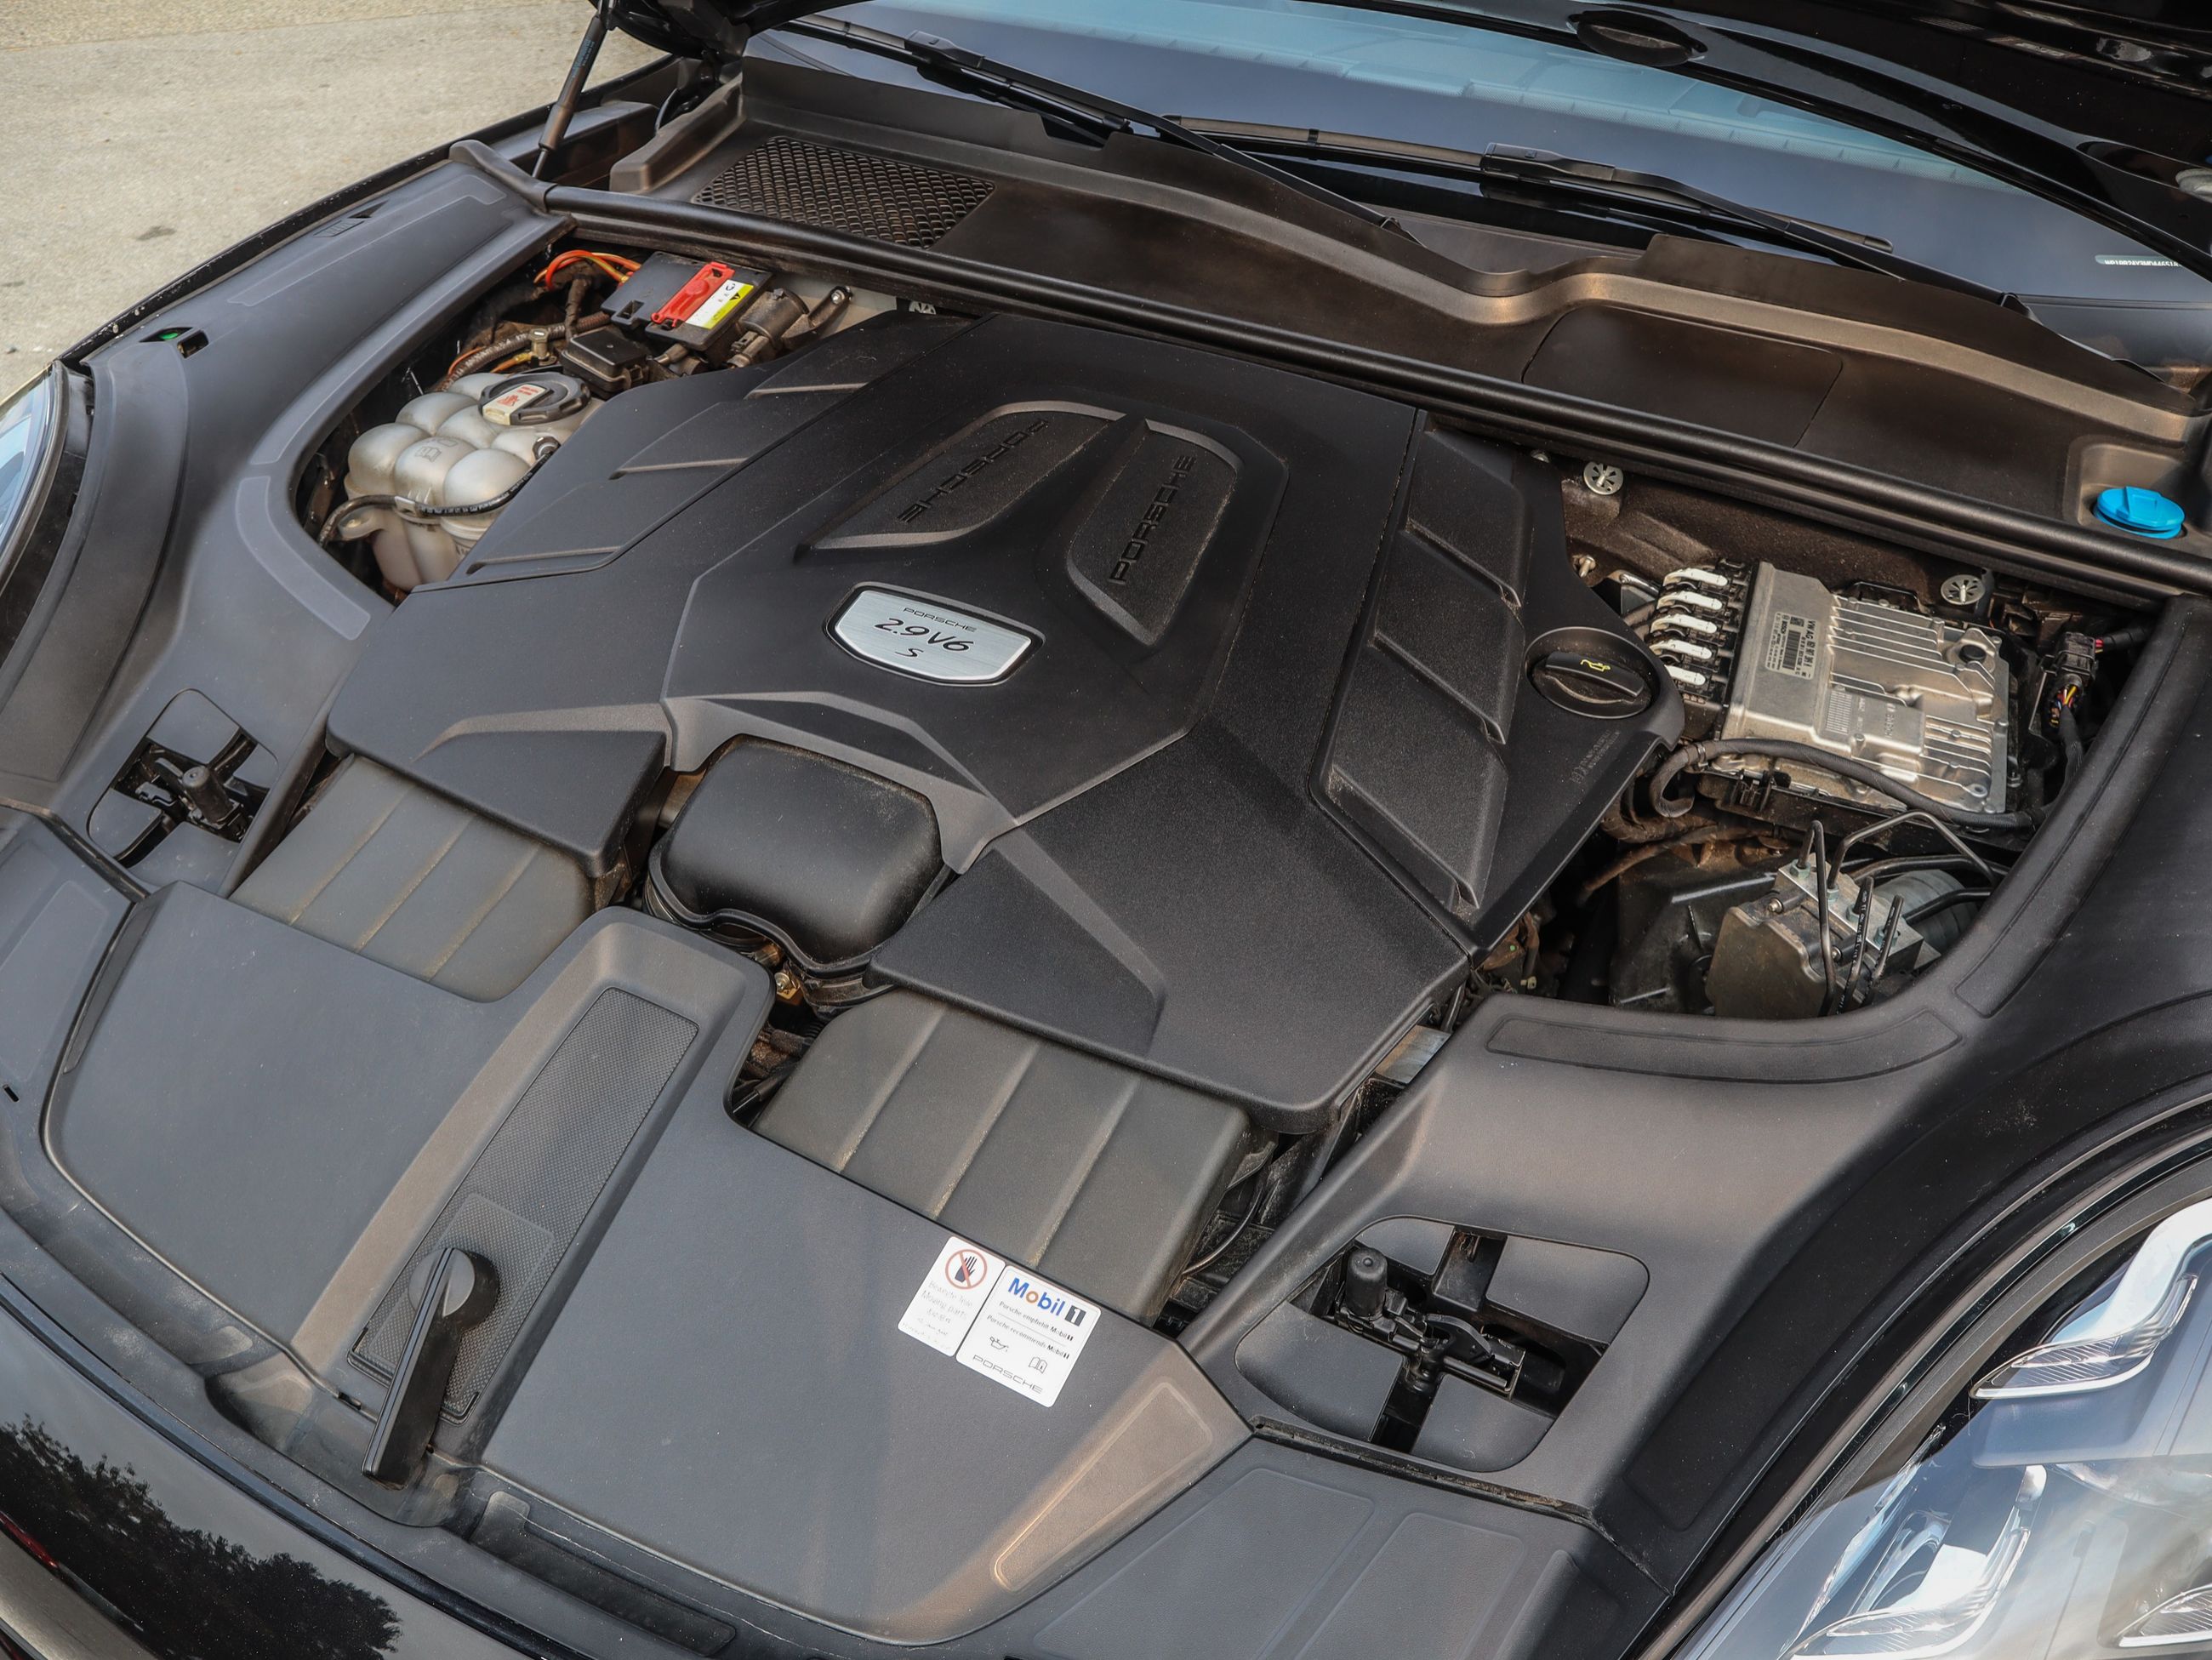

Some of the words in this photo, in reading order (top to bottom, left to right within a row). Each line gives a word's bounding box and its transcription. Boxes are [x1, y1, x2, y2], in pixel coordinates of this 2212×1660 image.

[897, 418, 1049, 524] PORSCHE
[1109, 454, 1197, 585] PORSCHE
[903, 607, 978, 633] PORSCHE
[895, 647, 925, 659] S
[999, 1301, 1022, 1316] Porsche
[1007, 1277, 1066, 1316] Mobil
[1068, 1307, 1084, 1325] 1
[987, 1315, 1009, 1330] Porsche
[972, 1354, 1044, 1395] PORSCHE
